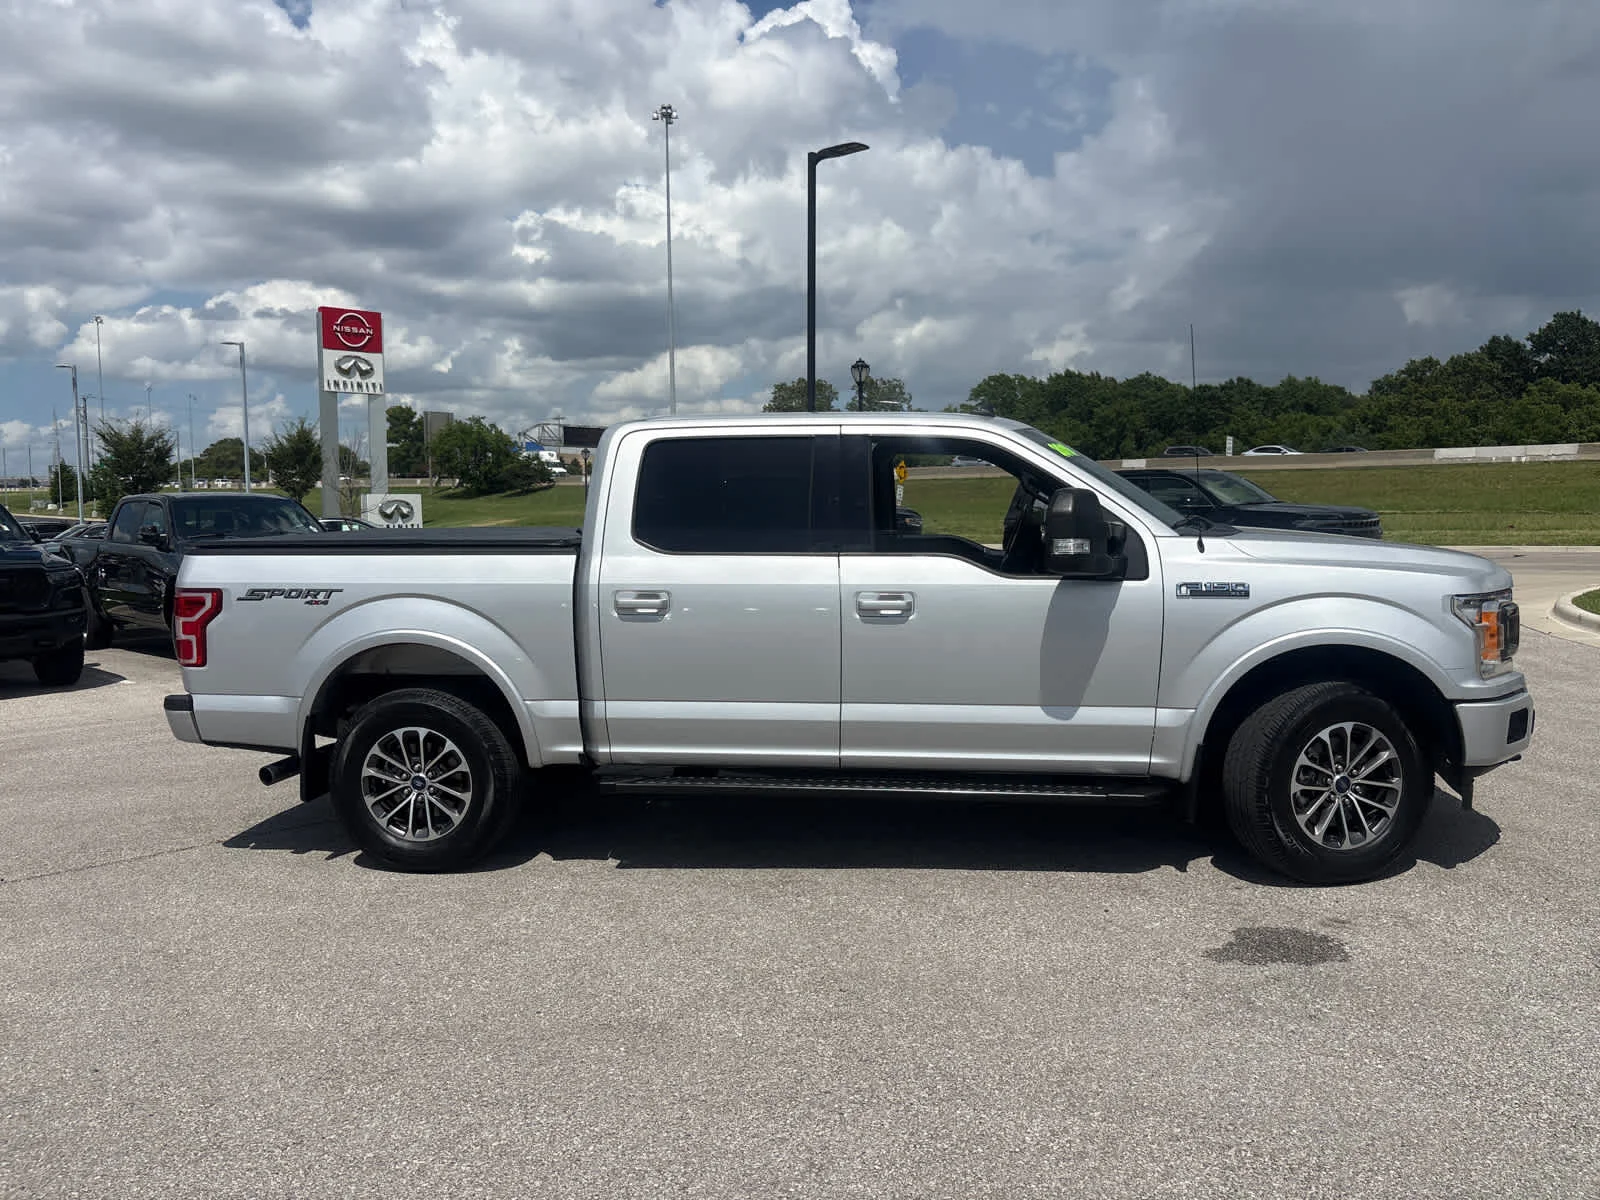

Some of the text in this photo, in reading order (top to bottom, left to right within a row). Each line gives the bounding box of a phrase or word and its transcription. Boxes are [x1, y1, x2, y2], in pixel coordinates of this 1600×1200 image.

[333, 325, 373, 335] NISSAN
[327, 379, 383, 393] INFINITI
[236, 588, 344, 601] SPORT
